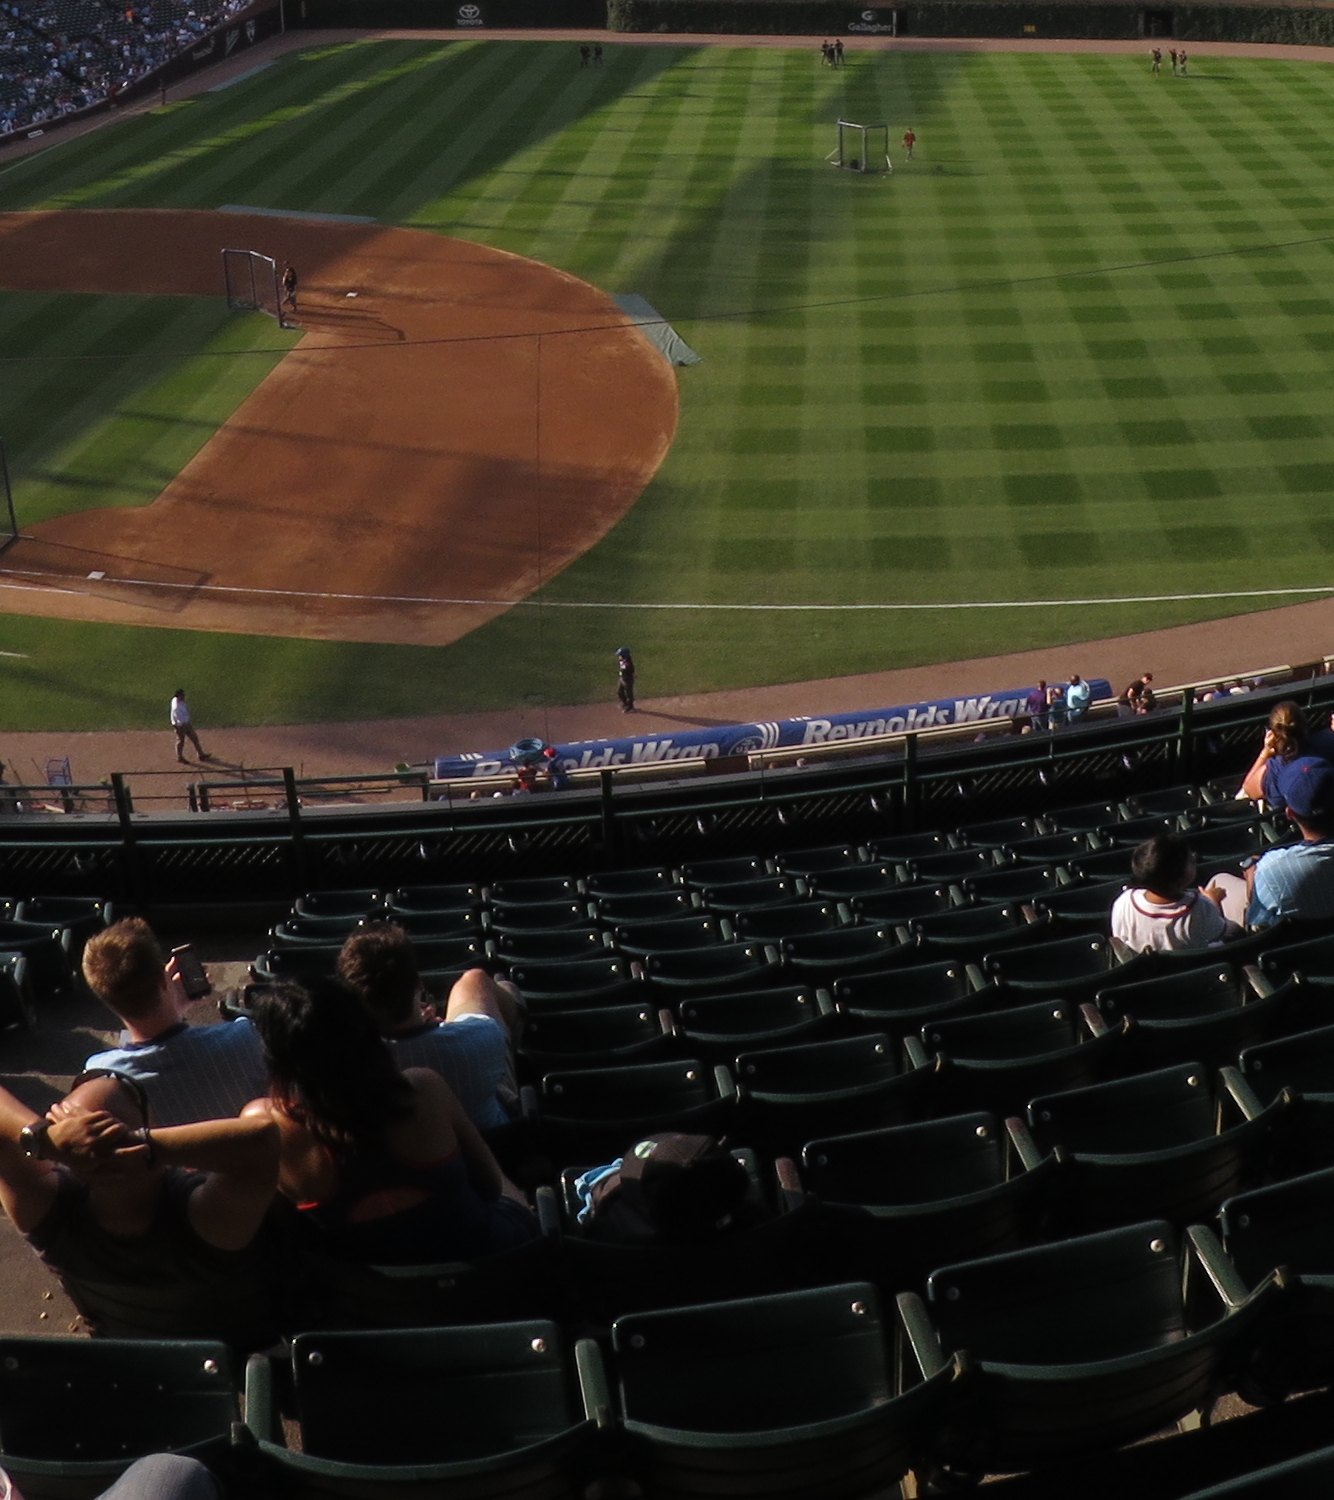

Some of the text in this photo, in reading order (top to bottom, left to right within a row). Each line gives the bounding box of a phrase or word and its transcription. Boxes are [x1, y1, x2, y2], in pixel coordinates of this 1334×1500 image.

[456, 18, 484, 26] TOYOTA
[848, 22, 893, 34] Gallagher
[802, 705, 950, 745] Reynolds
[631, 739, 720, 764] Wrap
